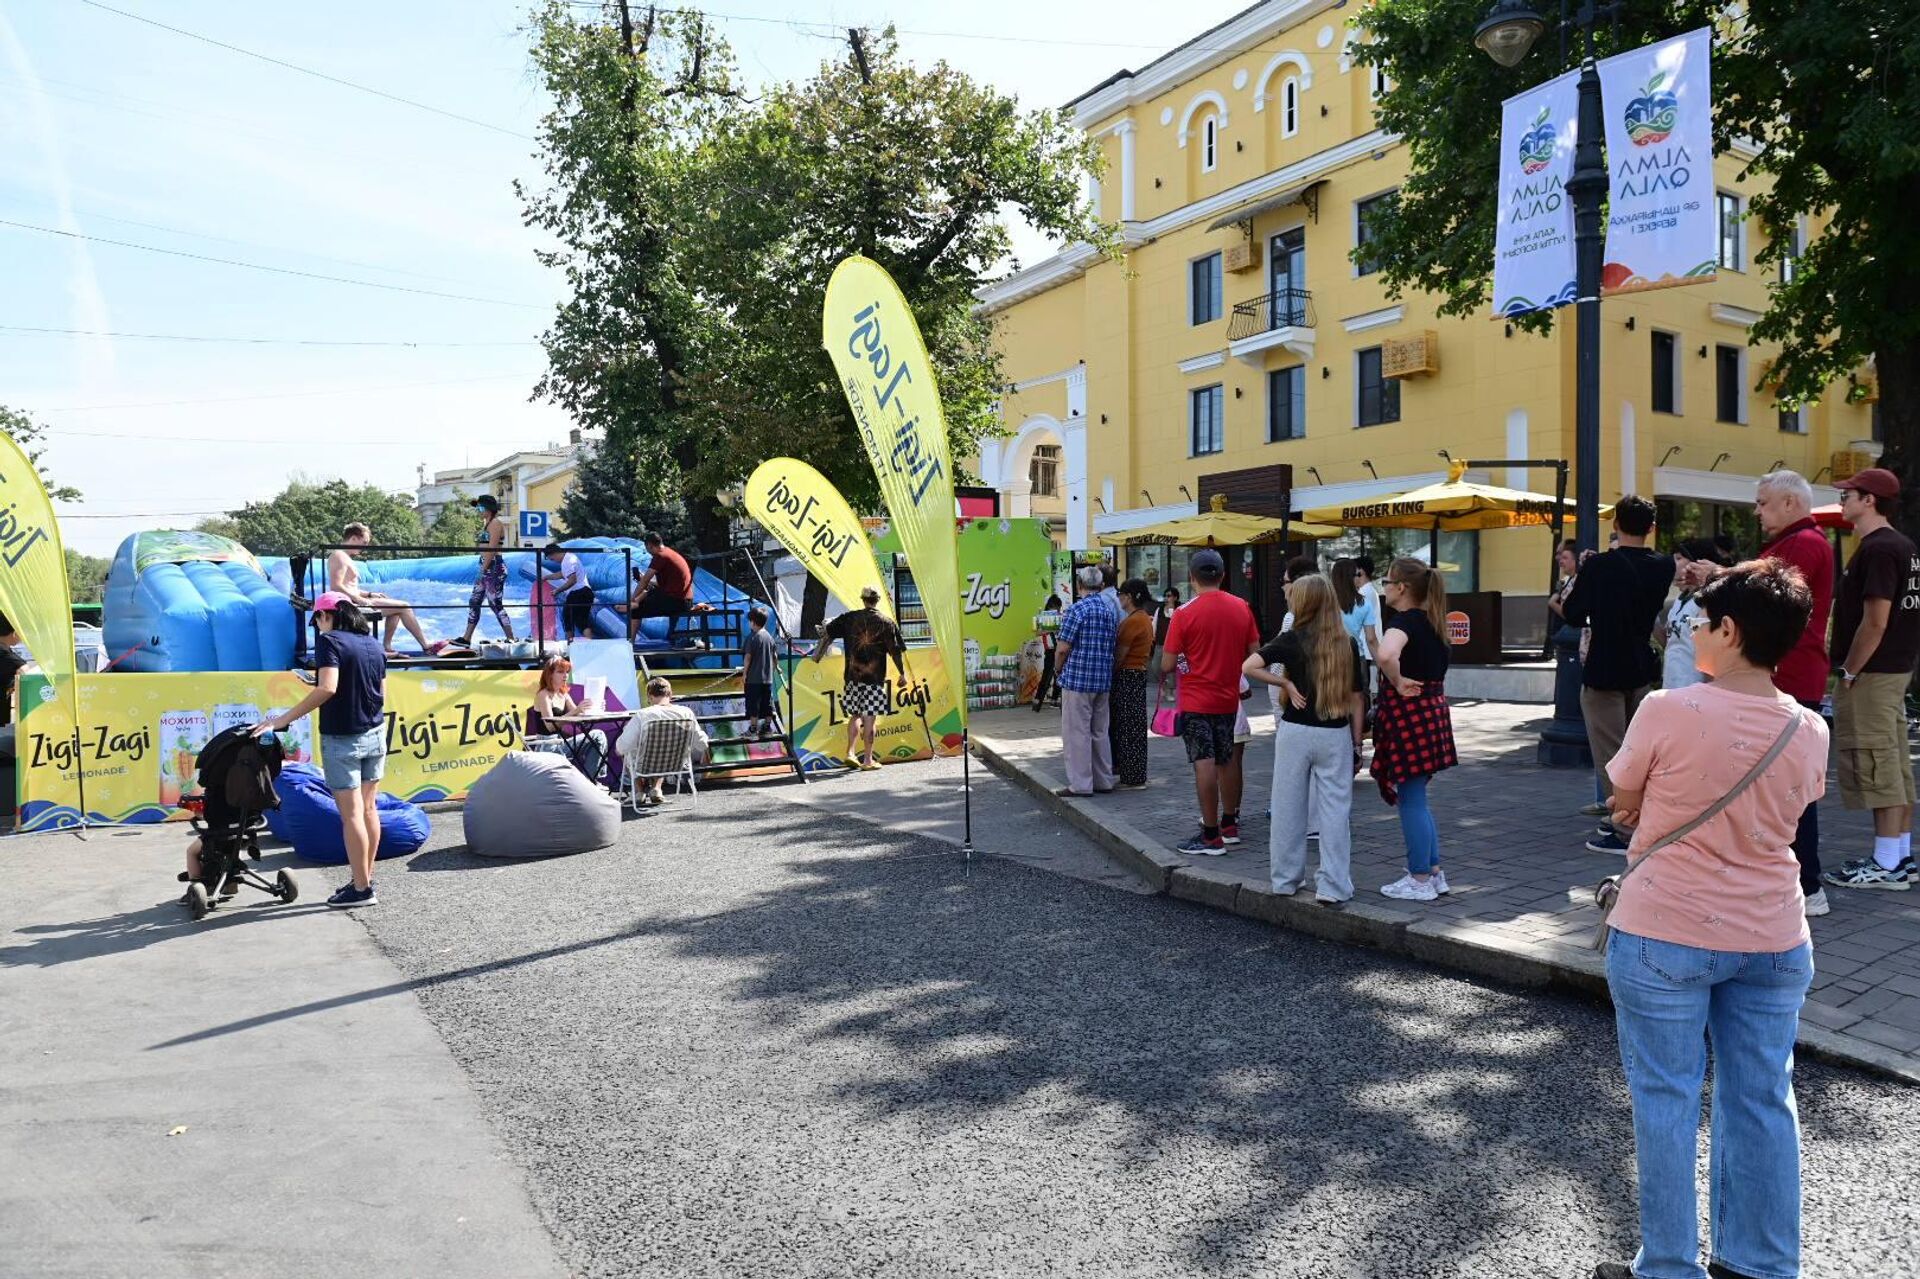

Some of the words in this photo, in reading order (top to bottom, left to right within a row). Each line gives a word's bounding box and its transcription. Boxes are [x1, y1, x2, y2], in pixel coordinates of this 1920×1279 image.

[1342, 502, 1390, 520] BURGER
[1392, 500, 1425, 516] KING
[526, 513, 542, 535] P
[1450, 629, 1469, 638] ING
[821, 678, 931, 726] ZiZagi
[383, 703, 522, 760] Zigi-Zagi
[873, 723, 913, 738] MONADE
[29, 725, 150, 771] Zigi-Zagi
[421, 754, 496, 774] LEMONADE
